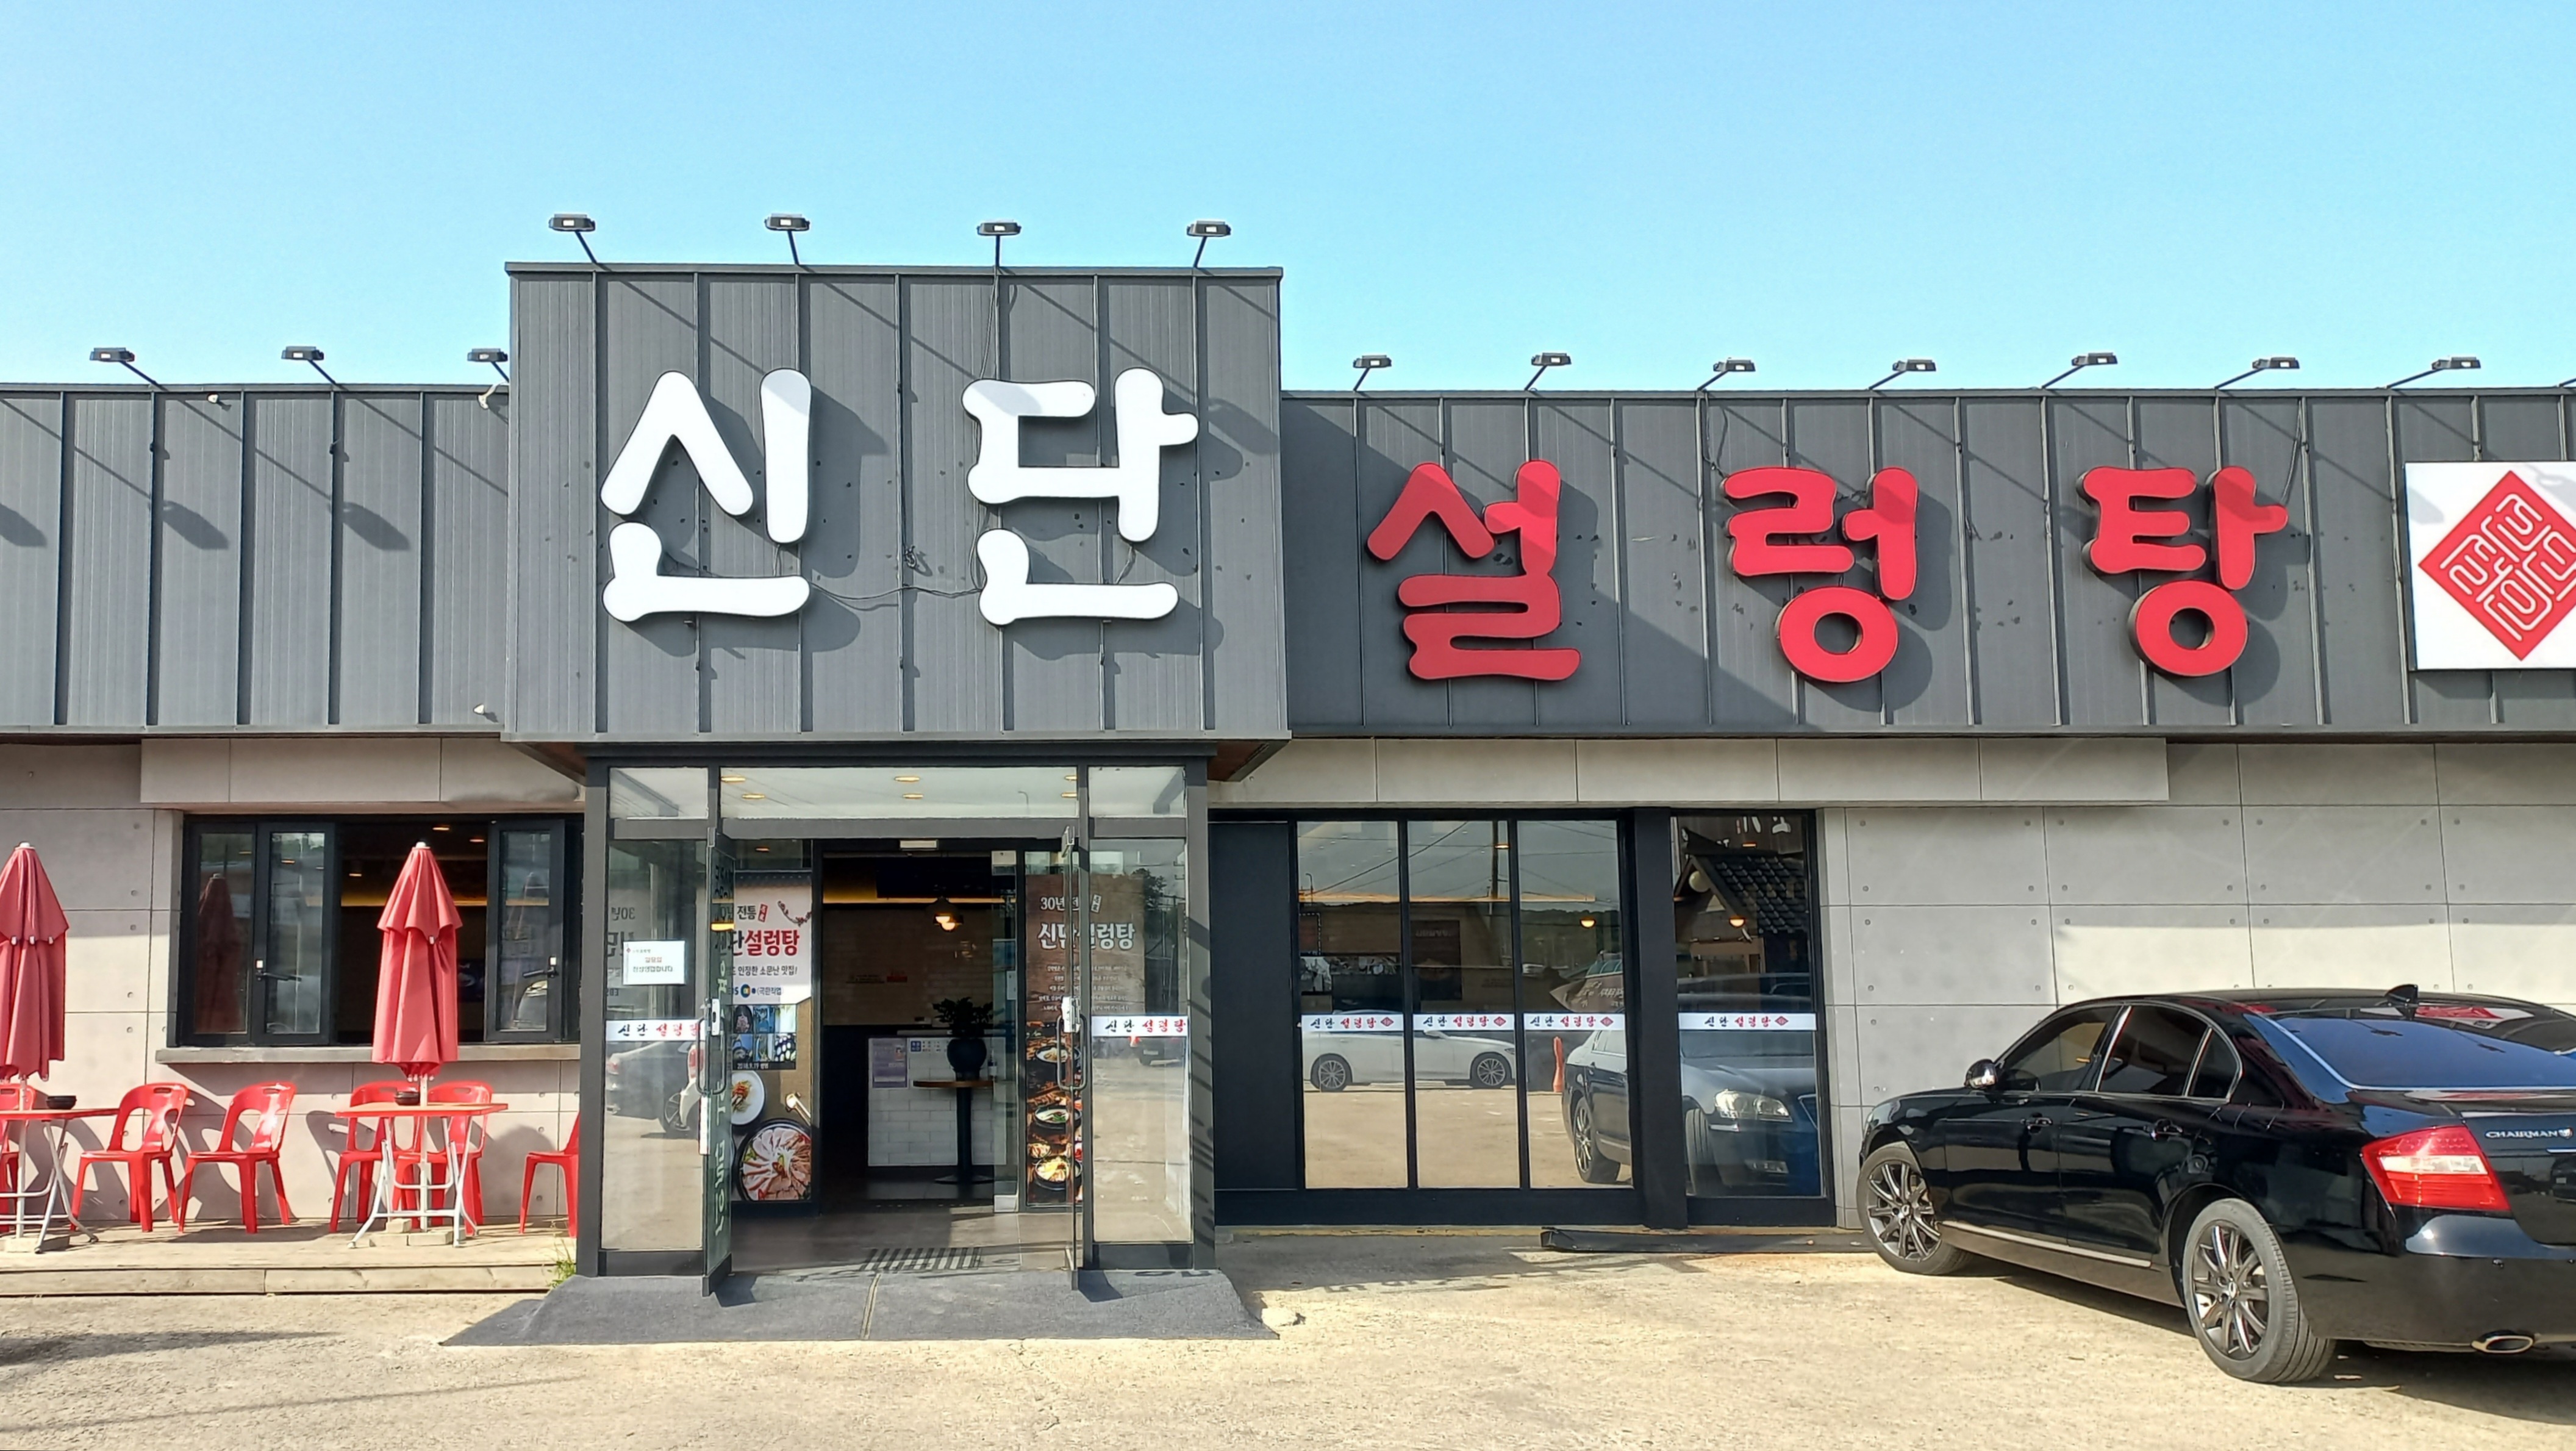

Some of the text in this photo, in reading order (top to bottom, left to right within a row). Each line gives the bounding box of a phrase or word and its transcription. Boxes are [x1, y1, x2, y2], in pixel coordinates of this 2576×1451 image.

[600, 367, 1199, 626] 신단
[1367, 460, 2289, 683] 설렁탕
[2485, 1130, 2558, 1139] CHAIRMAN
